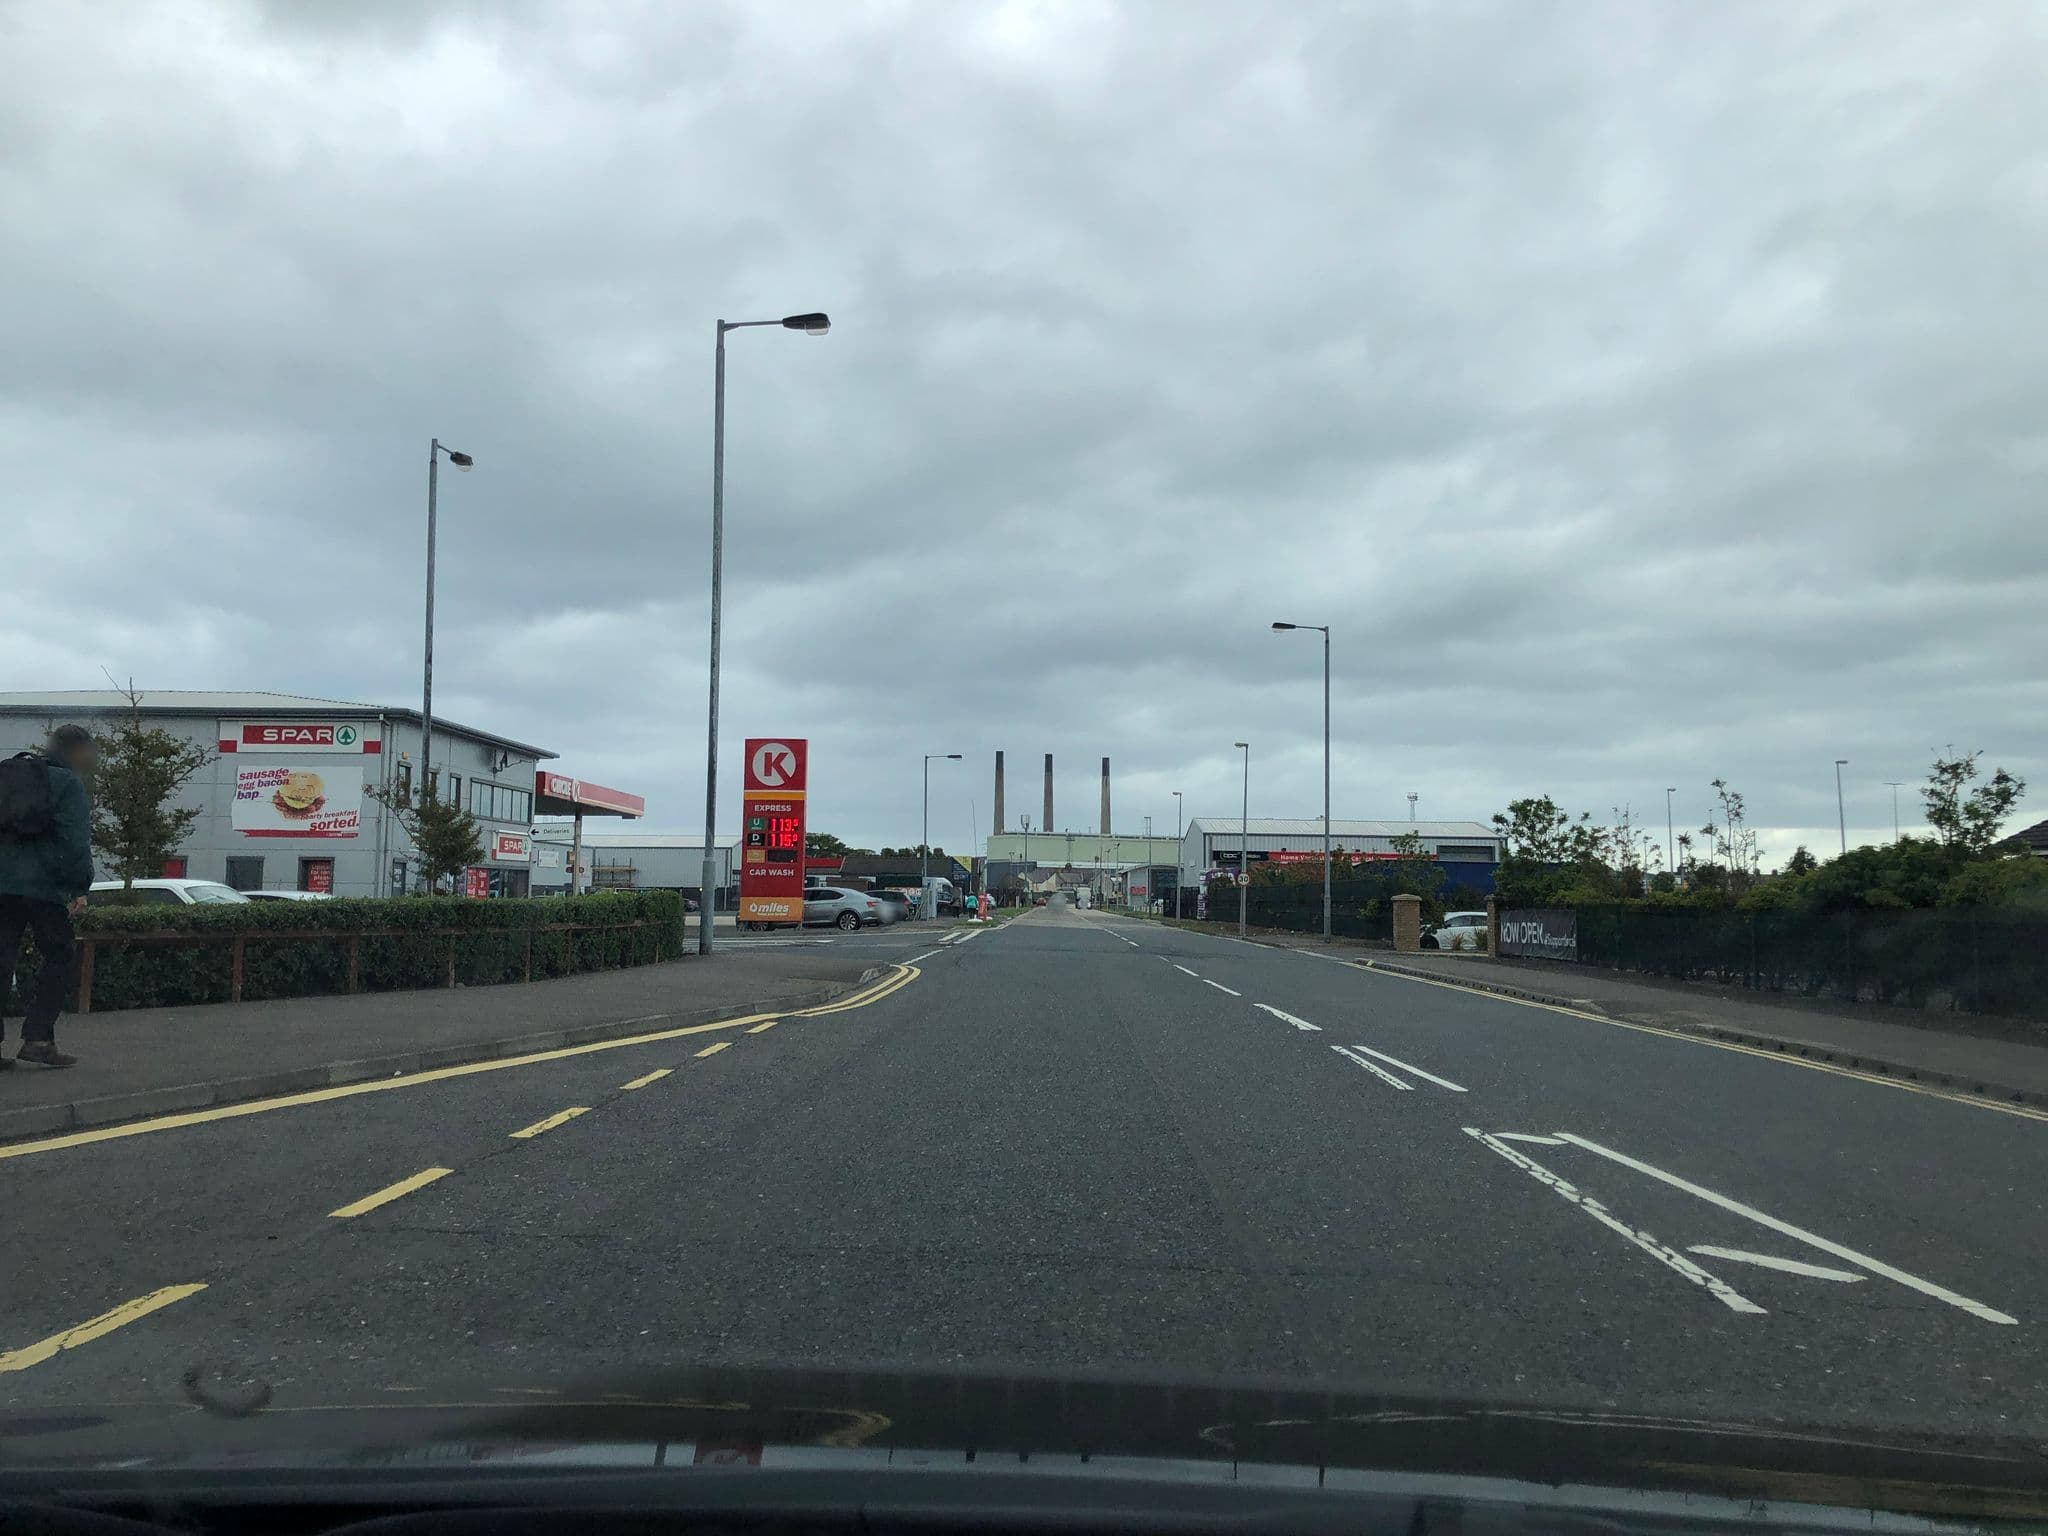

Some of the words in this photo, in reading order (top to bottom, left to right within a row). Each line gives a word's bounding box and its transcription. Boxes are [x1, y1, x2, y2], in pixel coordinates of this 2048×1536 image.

[263, 729, 332, 741] SPAR
[239, 767, 290, 780] sausage
[237, 780, 255, 790] egg
[257, 778, 290, 788] bacon
[754, 804, 792, 812] EXPRESS
[324, 809, 358, 818] breakfast
[310, 815, 360, 831] sorted.
[753, 817, 760, 826] U
[543, 827, 571, 835] Deliveries
[752, 833, 760, 841] D
[504, 840, 523, 853] SPAR
[1239, 875, 1248, 883] 30
[758, 903, 789, 913] miles
[1500, 922, 1519, 943] NOW
[1520, 922, 1544, 945] OPEN
